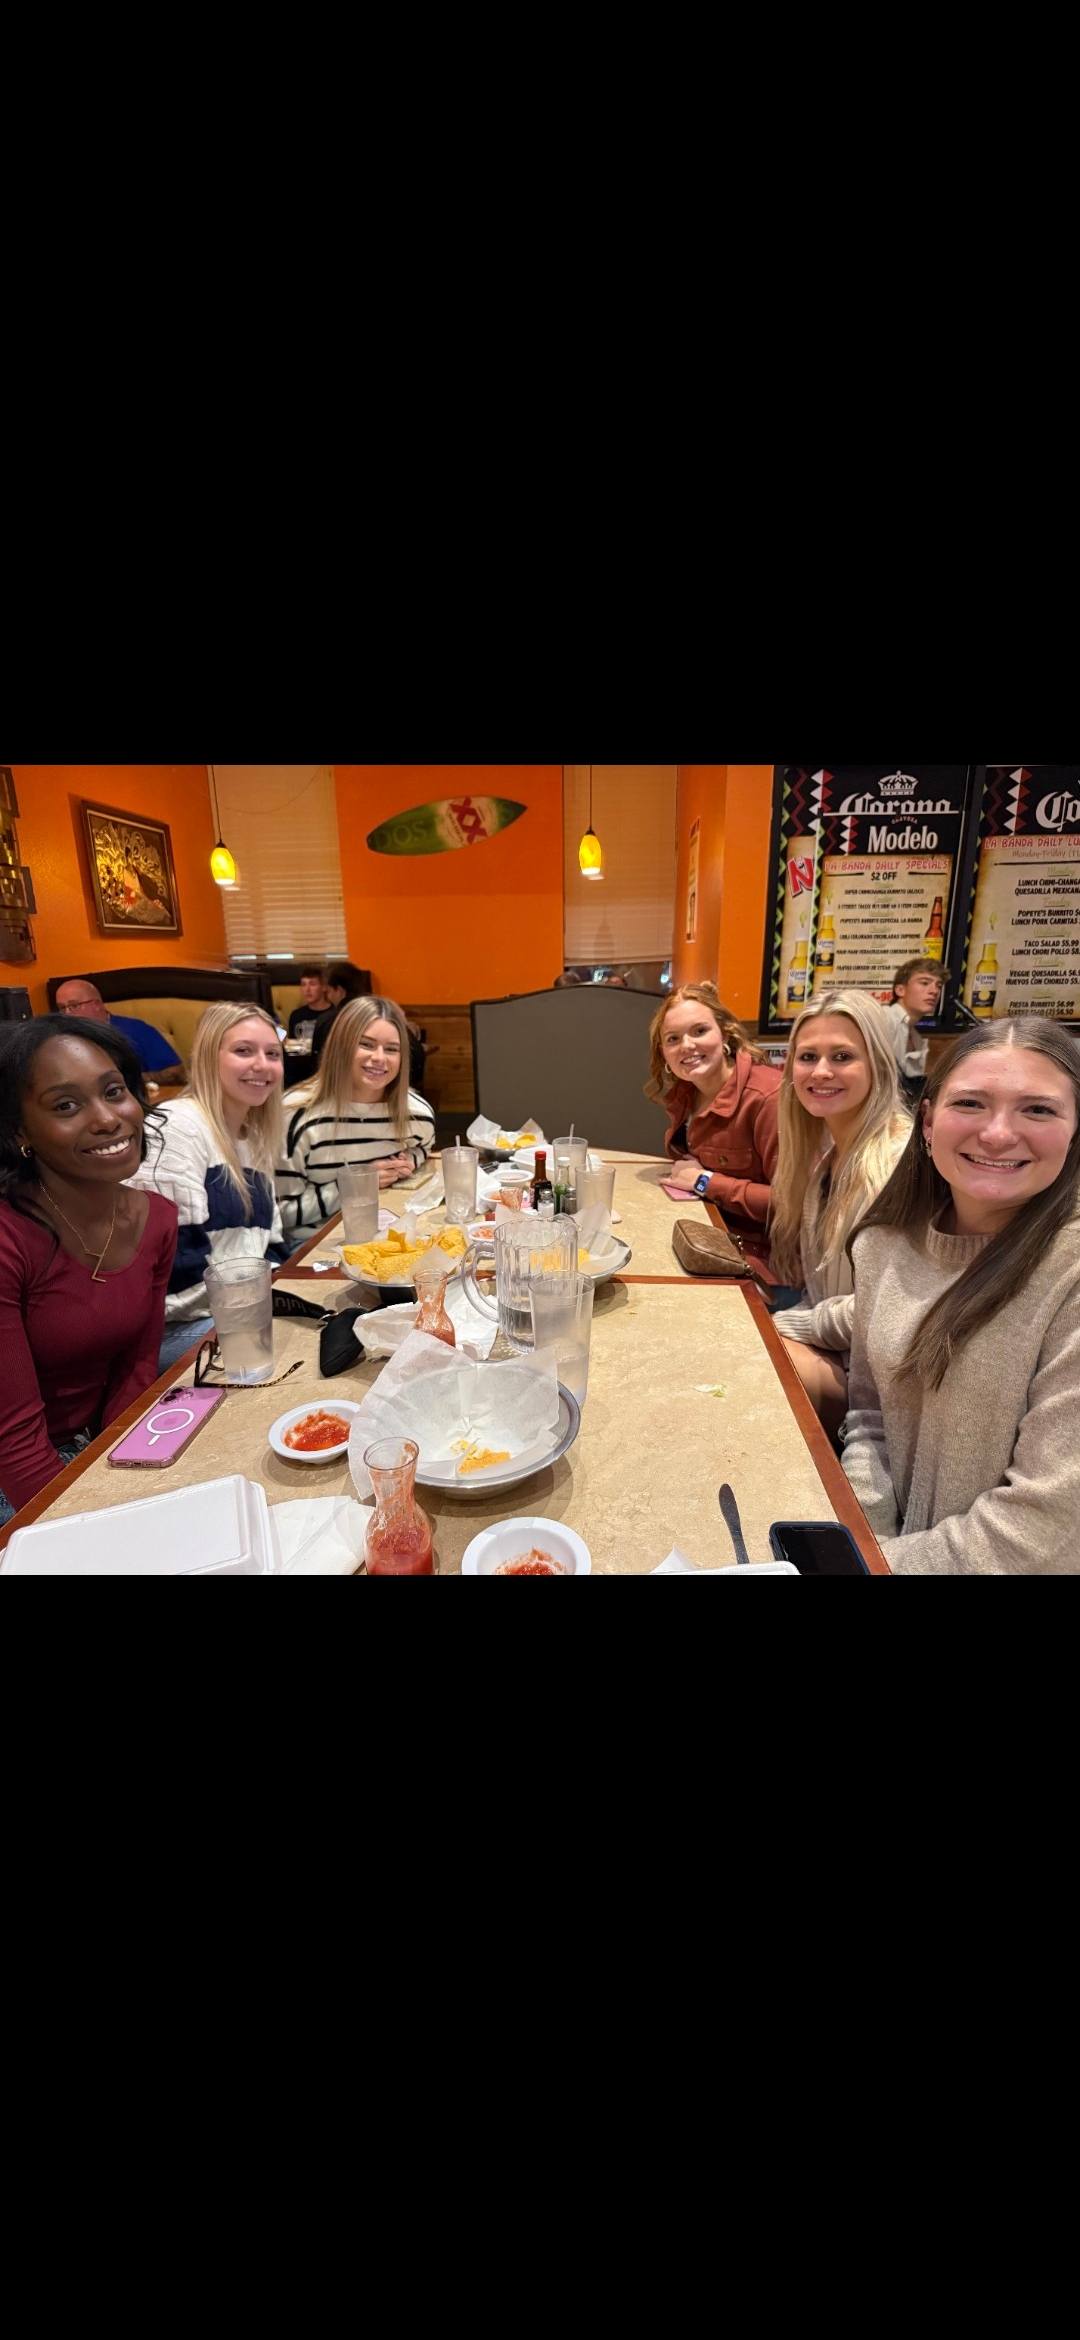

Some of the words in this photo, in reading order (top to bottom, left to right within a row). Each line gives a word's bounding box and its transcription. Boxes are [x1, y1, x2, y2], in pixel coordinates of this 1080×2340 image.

[867, 825, 938, 853] Modelo
[1002, 839, 1033, 848] BANDA
[1038, 838, 1063, 847] DAILY
[841, 862, 871, 871] BANDA
[875, 861, 900, 870] DAILY
[905, 860, 949, 870] SPECIALS
[871, 872, 881, 881] $2
[882, 871, 898, 880] OFF
[1018, 879, 1038, 887] LUNCH
[1015, 888, 1051, 896] QUESADILLA
[1048, 909, 1074, 917] BURRITO
[1011, 918, 1030, 926] LUNCH
[1024, 940, 1040, 948] TACO
[1031, 970, 1067, 978] QUESADILLA
